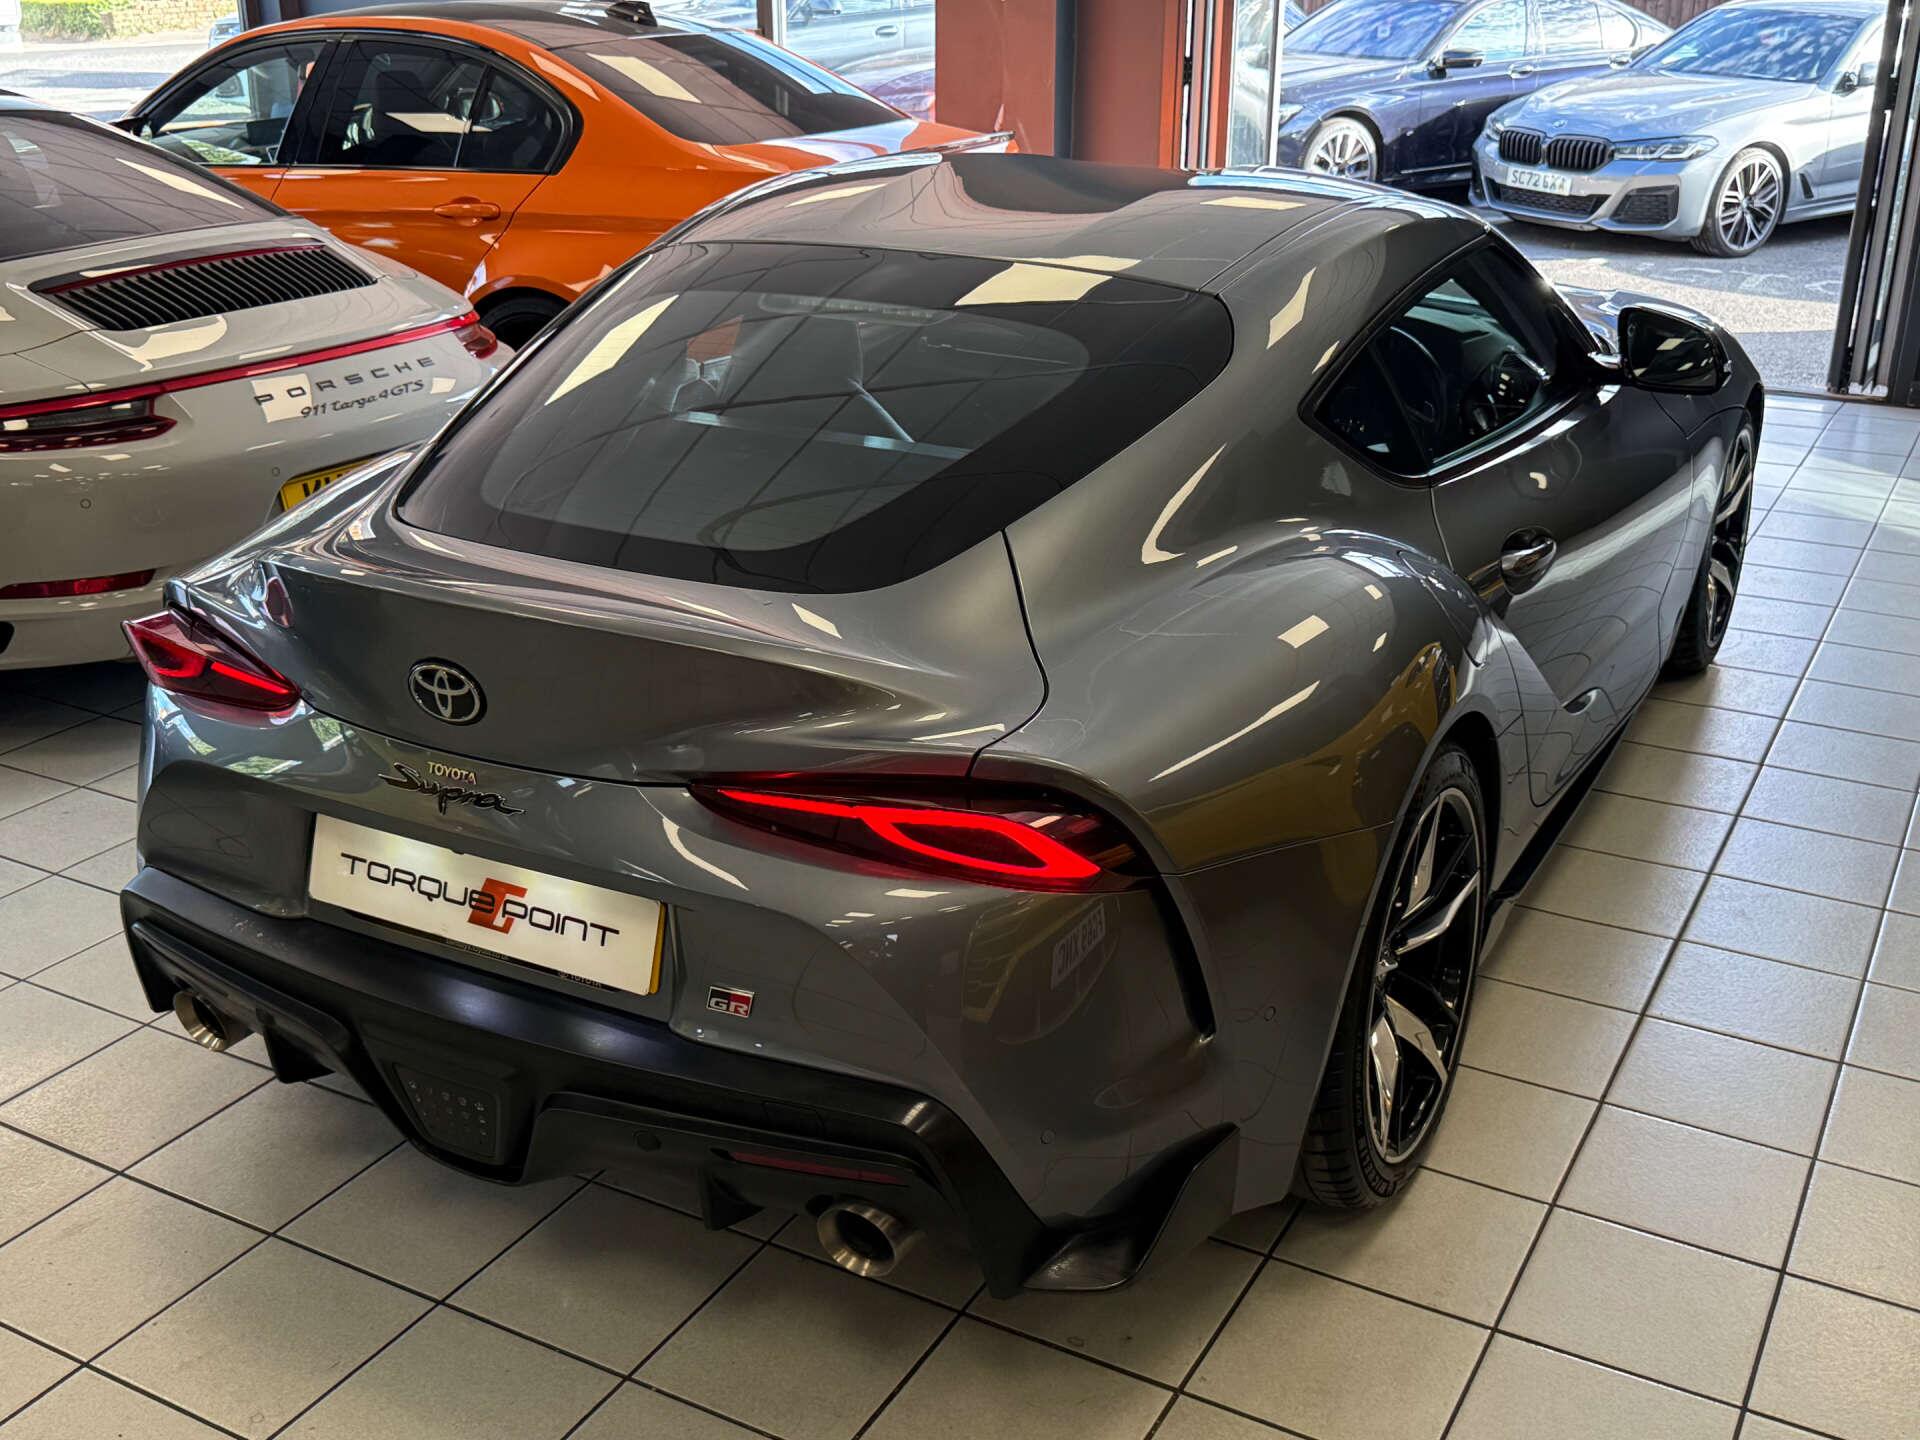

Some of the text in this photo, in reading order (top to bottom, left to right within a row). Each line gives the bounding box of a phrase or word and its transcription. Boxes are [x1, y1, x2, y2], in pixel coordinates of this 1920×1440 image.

[1511, 169, 1540, 187] SC72
[254, 357, 435, 406] PORSCHE
[301, 402, 327, 418] 911
[427, 761, 477, 785] TOYOTA
[377, 762, 527, 816] Supra
[501, 898, 620, 947] POINT
[709, 997, 748, 1015] GR
